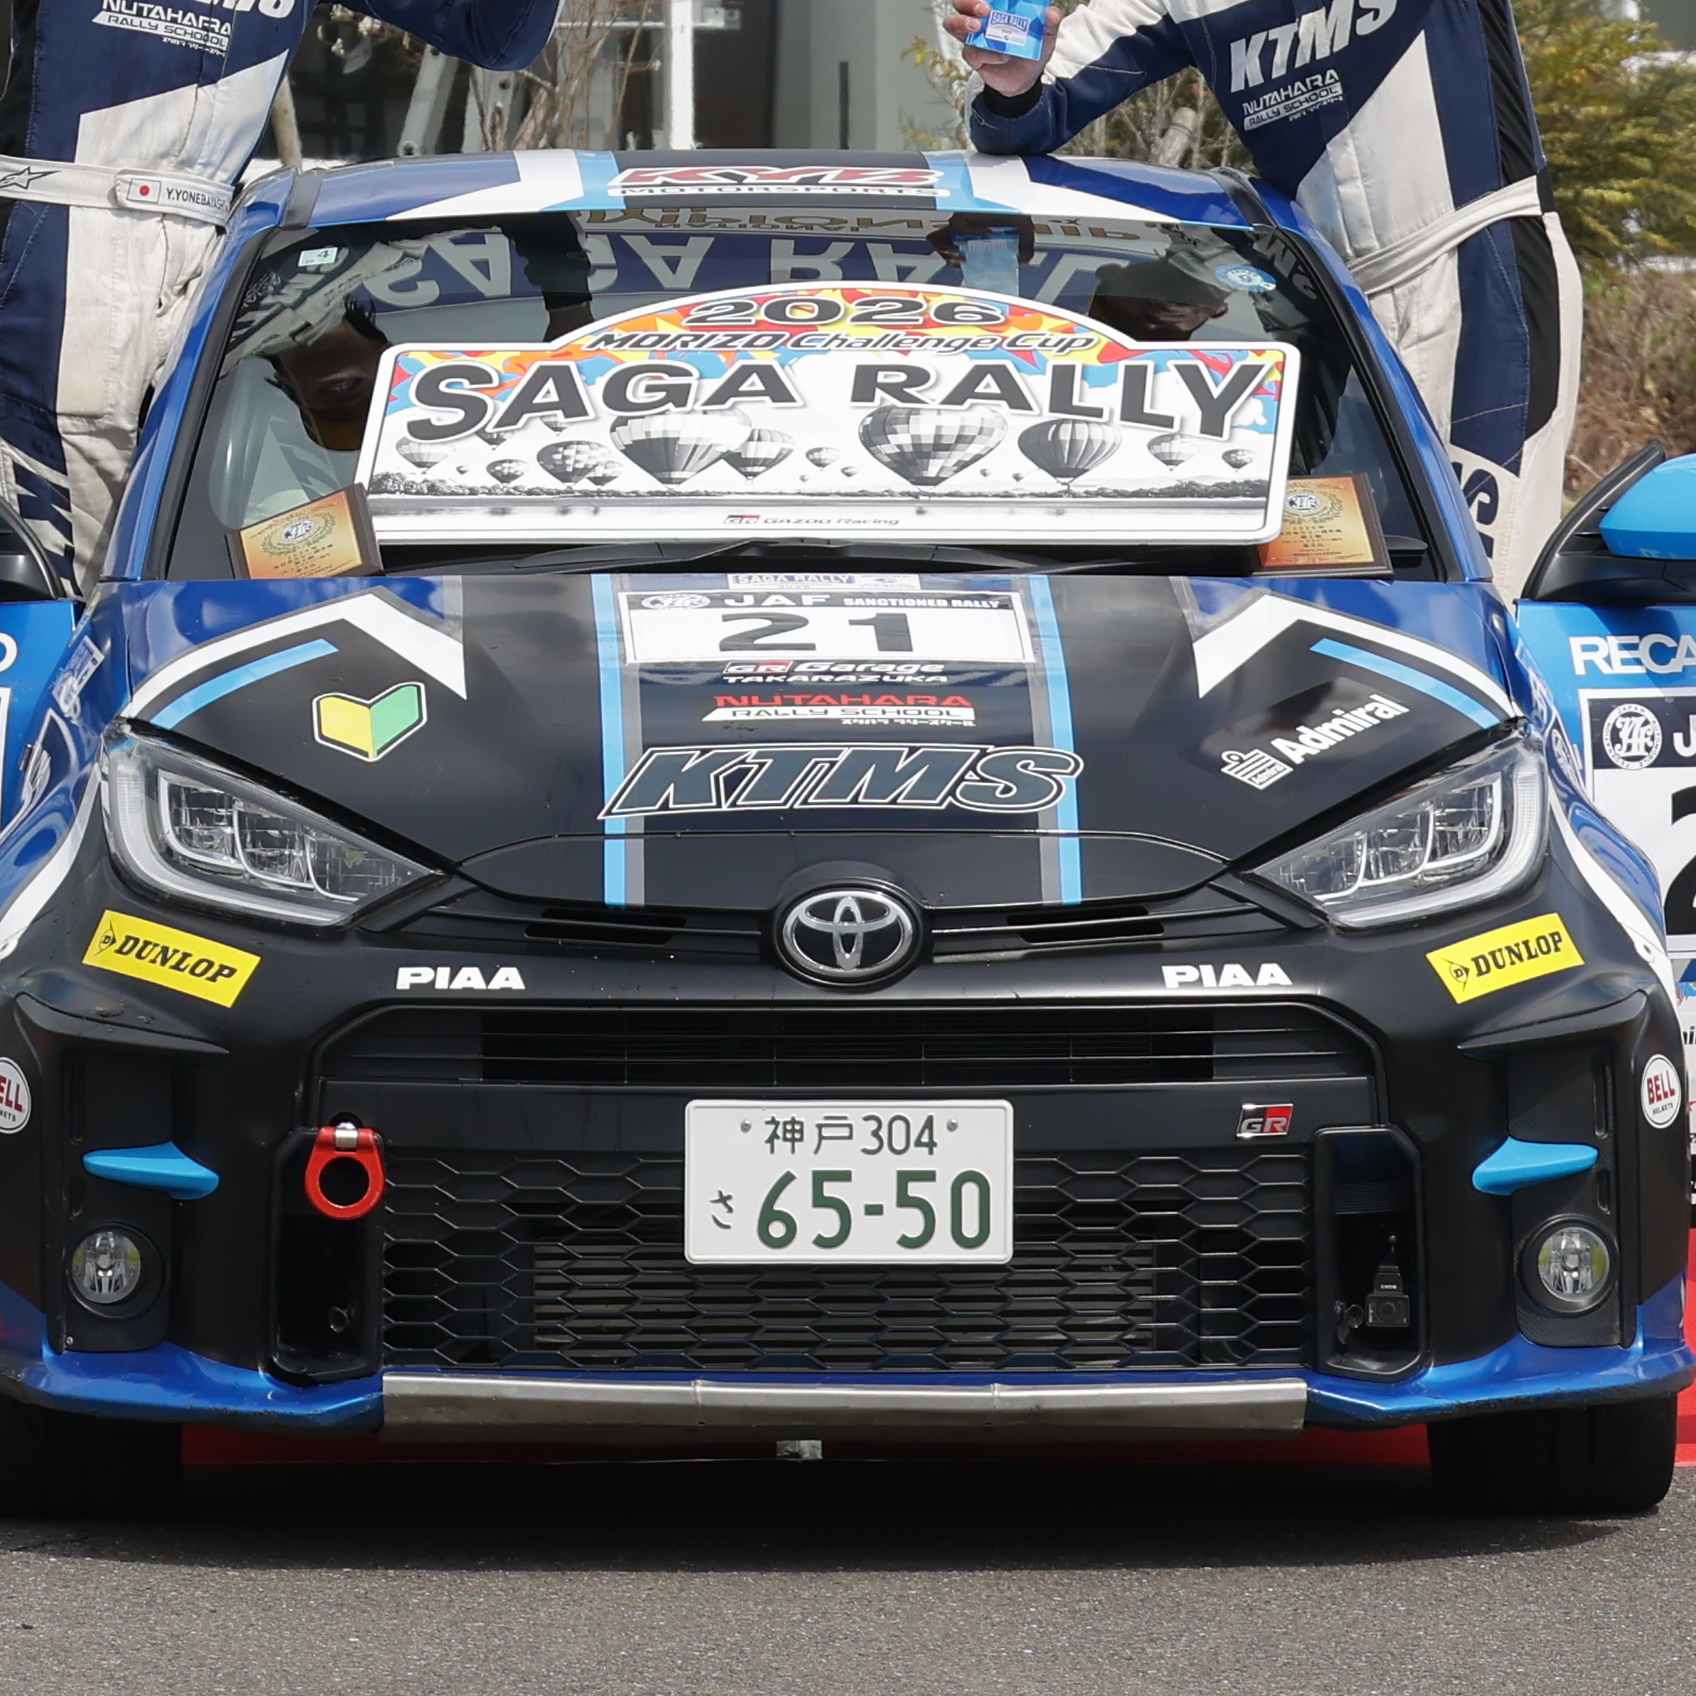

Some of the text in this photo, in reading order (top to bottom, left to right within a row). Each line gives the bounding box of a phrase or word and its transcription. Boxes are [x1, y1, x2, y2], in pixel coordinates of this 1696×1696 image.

[108, 15, 159, 31] RALLY
[163, 25, 227, 48] SCHOOL
[1242, 69, 1340, 115] NUTAHARA
[1249, 108, 1281, 127] RALLY
[1283, 85, 1341, 113] SCHOOL
[609, 167, 945, 186] KYB
[684, 297, 1004, 326] 2026
[584, 330, 1098, 355] MORIZO Challenge Cup
[406, 362, 1272, 442] SAGA RALLY
[724, 594, 1000, 609] JAF SANCTIONED RALLY
[718, 612, 915, 653] 21
[722, 674, 947, 684] TAKARAZUKA
[793, 662, 945, 675] Garage
[714, 695, 973, 708] NUTAHARA
[732, 707, 962, 717] RALLY SCHOOL
[1270, 693, 1410, 765] Admiral
[604, 746, 1081, 817] KTMS
[114, 934, 238, 984] DUNLOP
[1472, 929, 1563, 978] DUNLOP
[396, 965, 526, 991] PIAA
[1161, 963, 1293, 988] PIAA
[1647, 1071, 1676, 1104] BELL
[1652, 1102, 1674, 1115] HELMETS
[709, 1169, 991, 1249] さ 65-50
